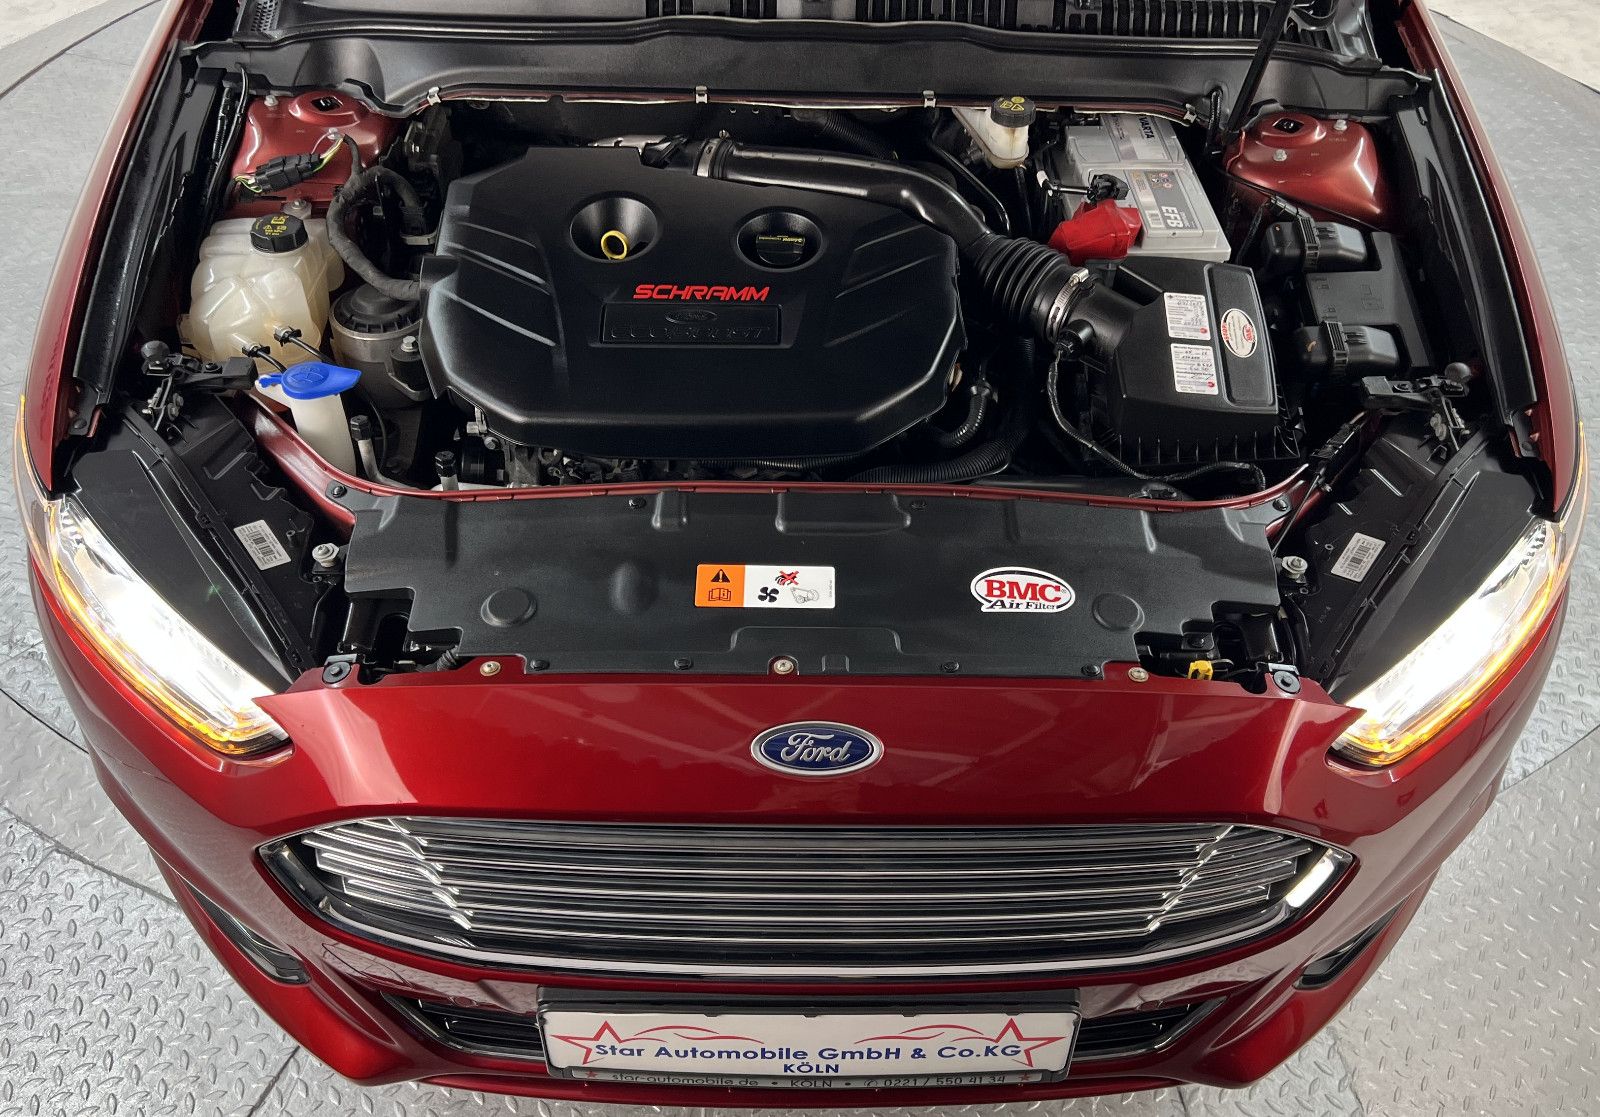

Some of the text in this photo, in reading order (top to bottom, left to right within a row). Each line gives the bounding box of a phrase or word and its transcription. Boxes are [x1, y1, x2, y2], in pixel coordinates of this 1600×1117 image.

[1139, 116, 1155, 139] VARTA
[1161, 206, 1184, 228] EFB
[633, 284, 770, 302] SCHRAMM
[984, 579, 1062, 603] BMC
[986, 599, 1056, 610] Air Filter
[780, 732, 852, 762] Ford
[595, 1044, 1022, 1060] Star Automobile GmbH & Co.KG
[783, 1061, 840, 1074] KÖLN
[612, 1072, 759, 1087] star-automobile.de
[936, 1076, 963, 1086] 550
